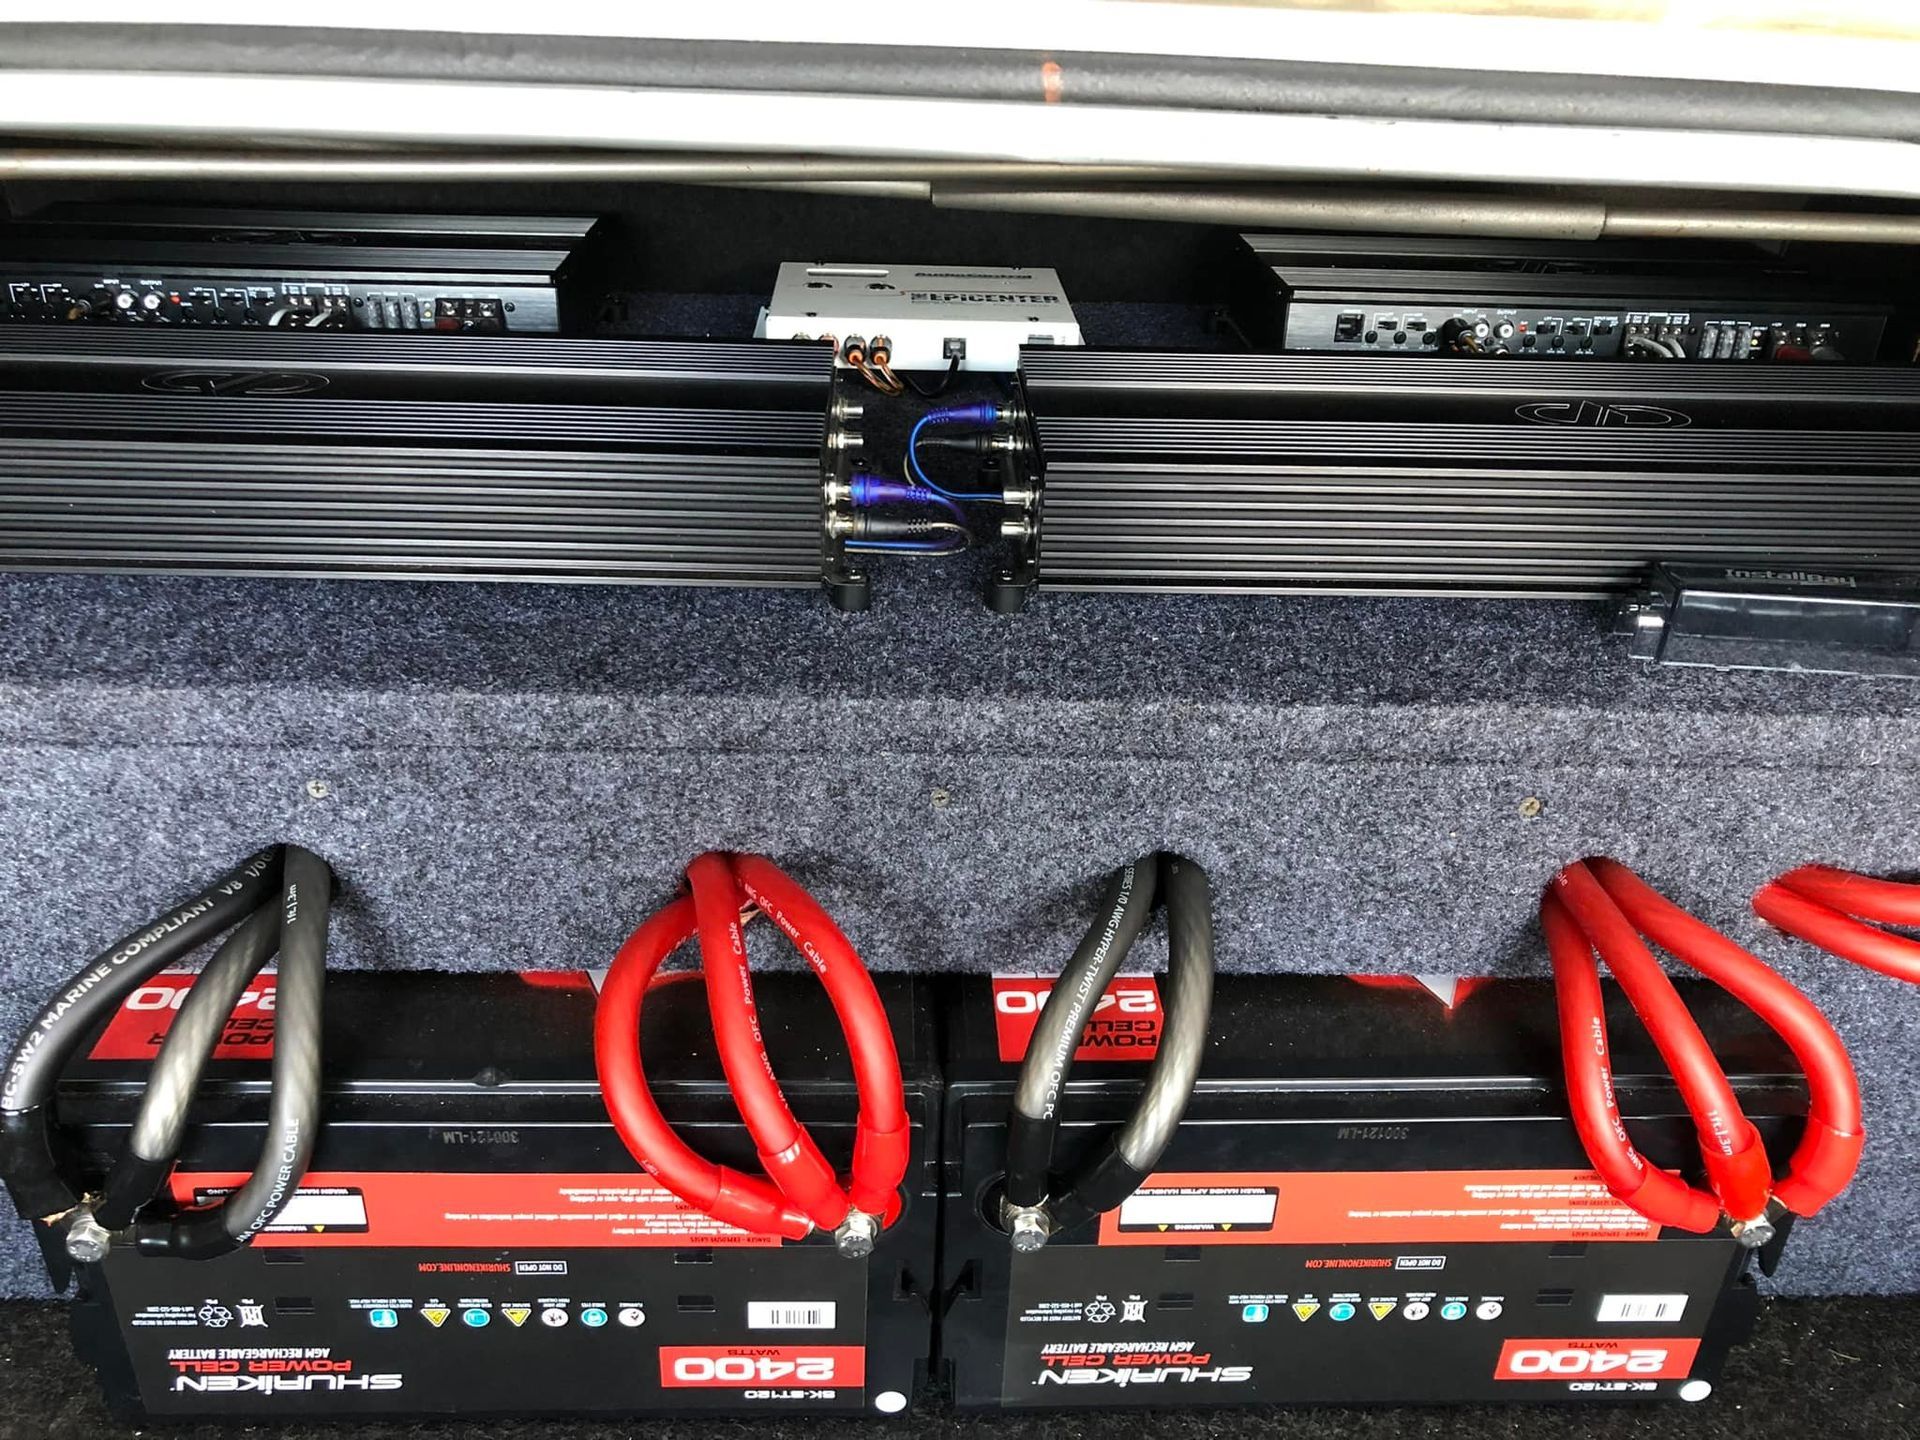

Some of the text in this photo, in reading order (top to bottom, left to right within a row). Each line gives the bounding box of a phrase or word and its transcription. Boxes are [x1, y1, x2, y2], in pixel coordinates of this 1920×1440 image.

[1108, 902, 1128, 929] AWG
[729, 921, 743, 955] Cable
[776, 910, 801, 938] Power
[803, 941, 828, 974] Cable
[42, 964, 114, 1031] MARINE
[112, 897, 216, 965] COMPLIANT
[218, 878, 244, 897] V8
[1074, 927, 1117, 1002] HYPER-TWIST
[748, 1015, 763, 1043] OFC
[1053, 1000, 1083, 1069] PREMIUM
[1592, 1016, 1605, 1057] Cable
[1045, 1072, 1062, 1101] OFC
[1611, 1116, 1627, 1142] OFC
[250, 1118, 300, 1230] OFC POWER CABLE
[418, 1262, 511, 1273] SHURIKENONLINE.COM
[519, 1263, 564, 1272] DO NOT OPEN
[1305, 1258, 1393, 1268] SHURIKENONLINE.COM
[1399, 1259, 1442, 1267] DO NOT OPEN
[168, 1347, 330, 1359] AGM RECHARGEABLE BATTERY
[727, 1349, 781, 1357] WATTS
[1041, 1341, 1196, 1354] AGM RECHARGEABLE BATTERY
[169, 1360, 352, 1373] POWER CELL
[673, 1356, 835, 1381] 2400
[1040, 1353, 1211, 1367] POWER CELL
[1510, 1349, 1668, 1373] 2400
[744, 1389, 837, 1399] SK-BT120
[1569, 1382, 1659, 1392] SK-BT120
